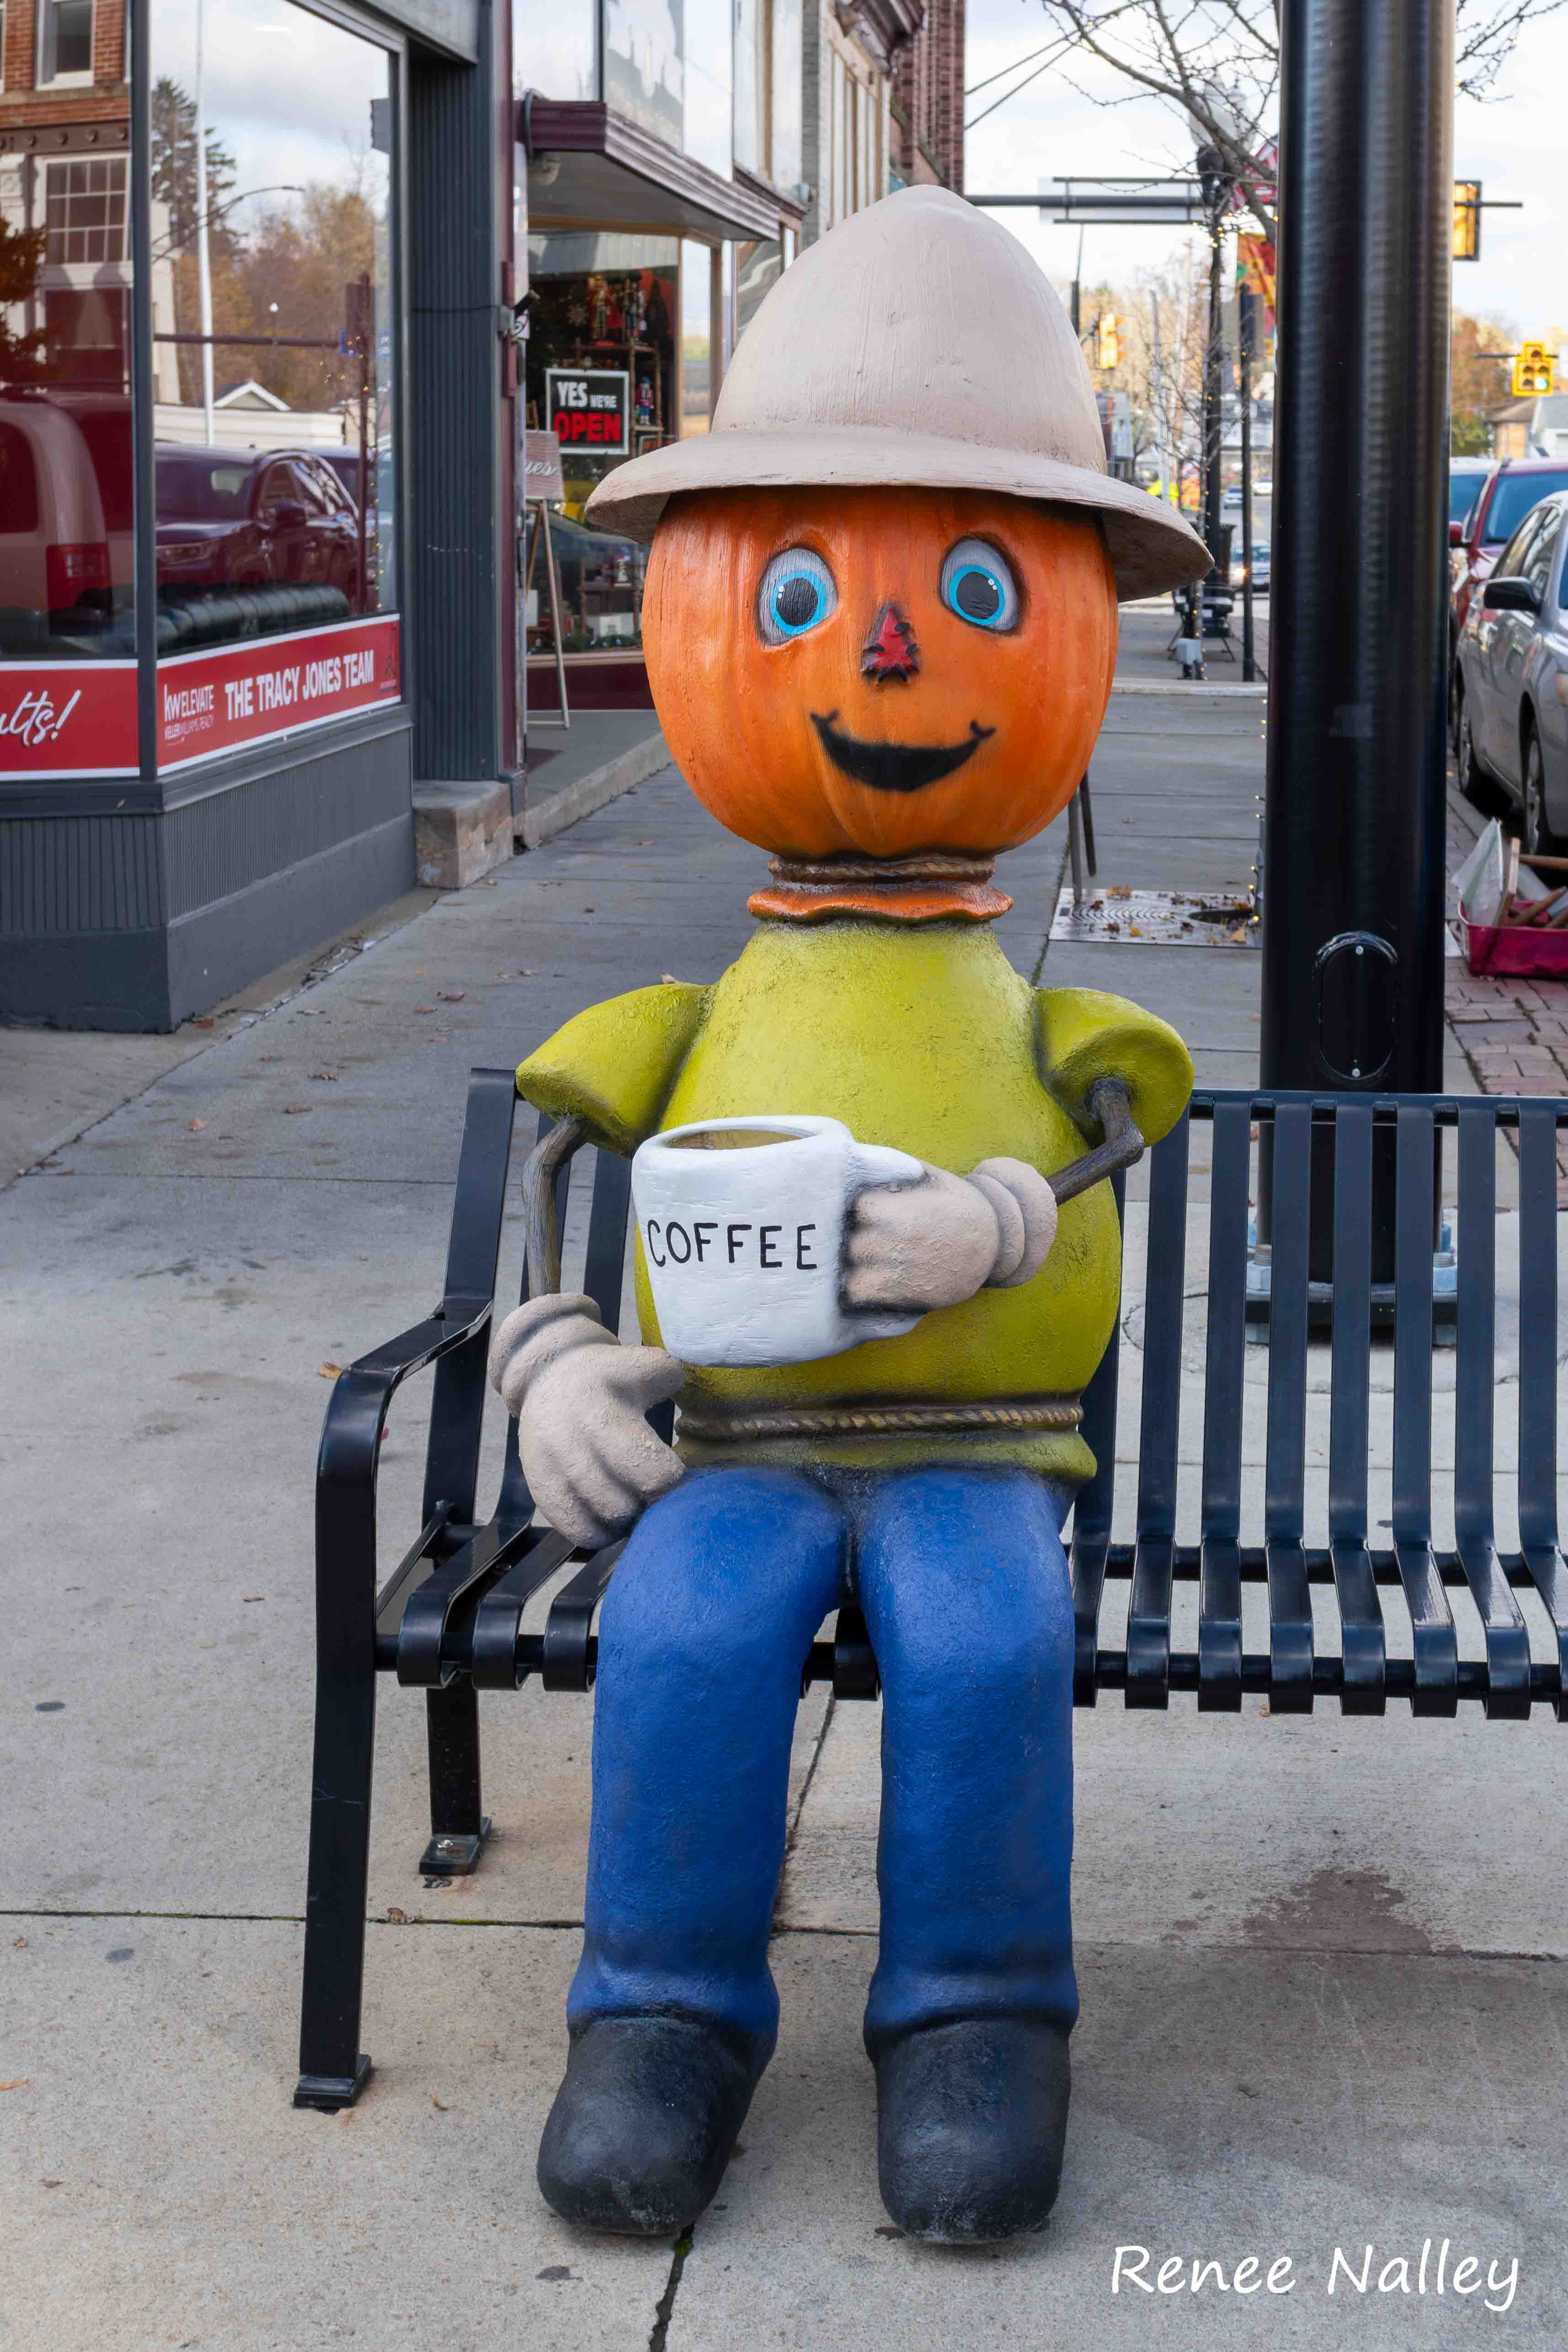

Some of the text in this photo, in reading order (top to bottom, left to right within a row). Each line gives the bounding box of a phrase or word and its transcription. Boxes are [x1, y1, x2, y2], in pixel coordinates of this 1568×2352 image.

[556, 381, 588, 407] YES
[553, 411, 621, 442] OPEN
[181, 684, 214, 717] ELEVATE
[225, 649, 374, 721] THE TRACY JONES TEAM
[647, 1219, 818, 1270] COFFEE
